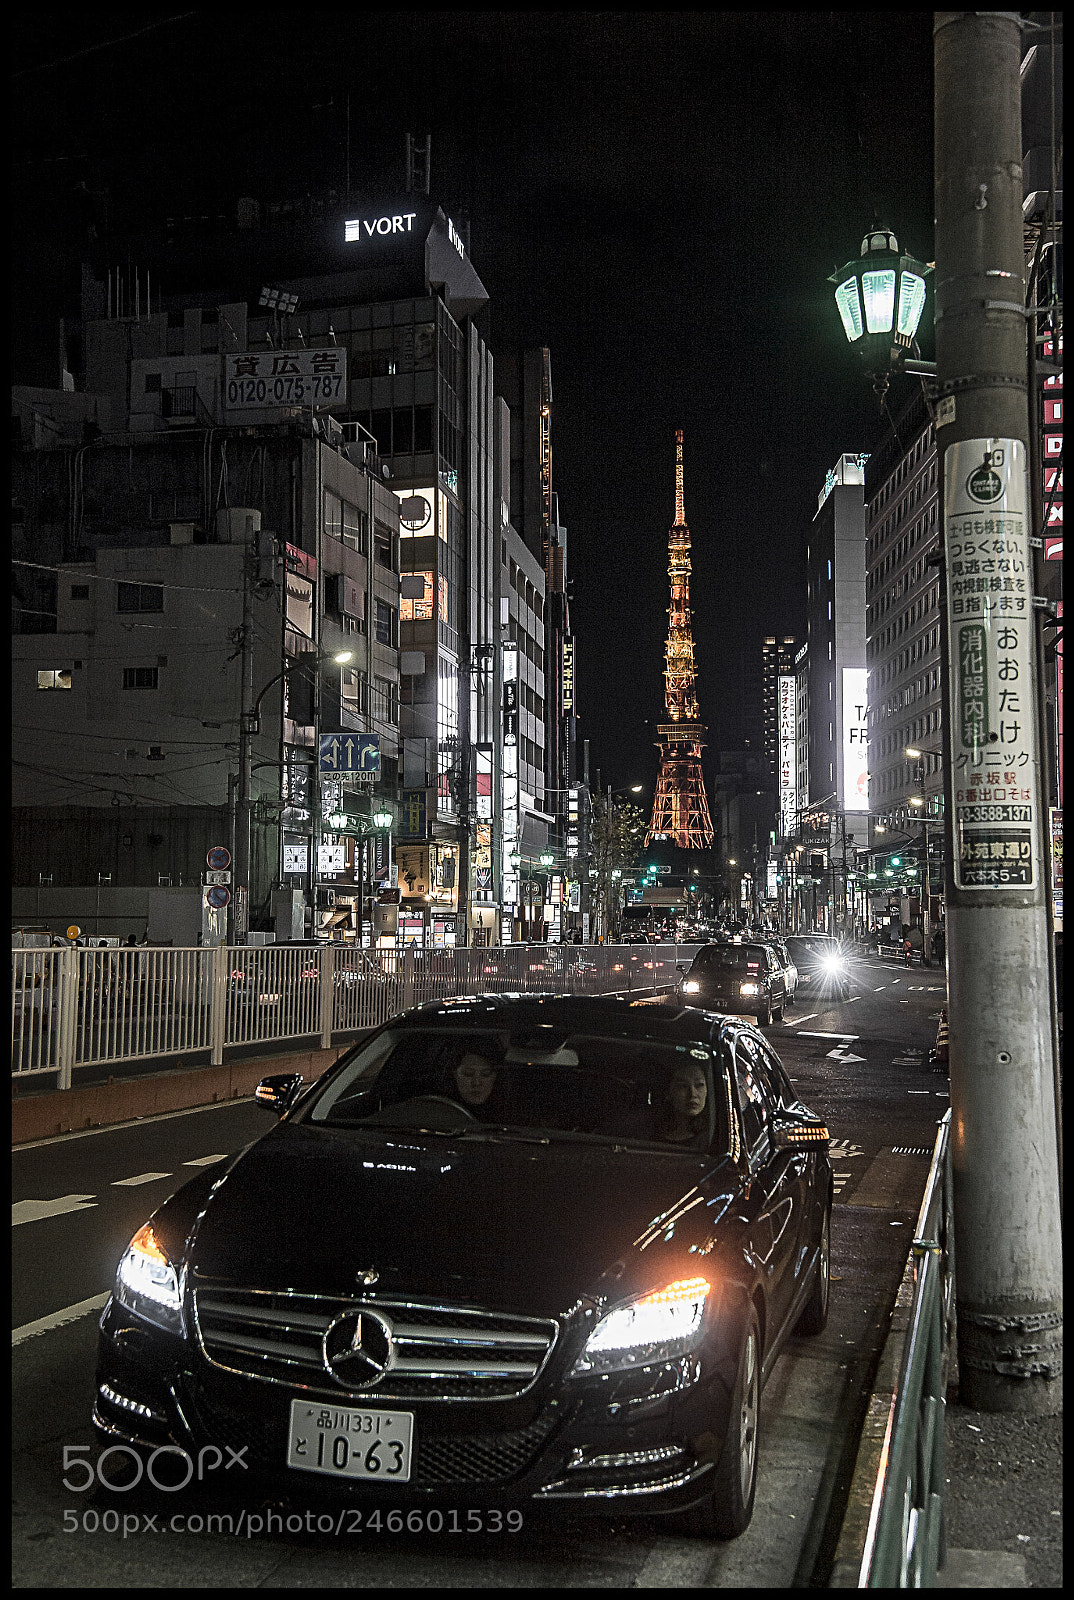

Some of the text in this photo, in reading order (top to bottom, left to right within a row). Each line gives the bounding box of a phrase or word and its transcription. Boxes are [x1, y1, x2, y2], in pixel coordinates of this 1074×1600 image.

[363, 212, 417, 237] VORT
[232, 352, 340, 377] 貸広告
[228, 375, 343, 403] 0120-075-787
[951, 558, 1025, 577] 見逃さない
[953, 596, 1027, 614] 目指します
[962, 629, 985, 743] 消化器内科
[997, 626, 1021, 743] おおたけ
[957, 750, 1029, 769] クリニック
[323, 771, 376, 782] この先120m
[970, 771, 1017, 786] 赤坂駅
[956, 787, 1031, 802] 6番出口そば
[962, 841, 1031, 860] 外苑東通り
[296, 1431, 405, 1474] と 10-63
